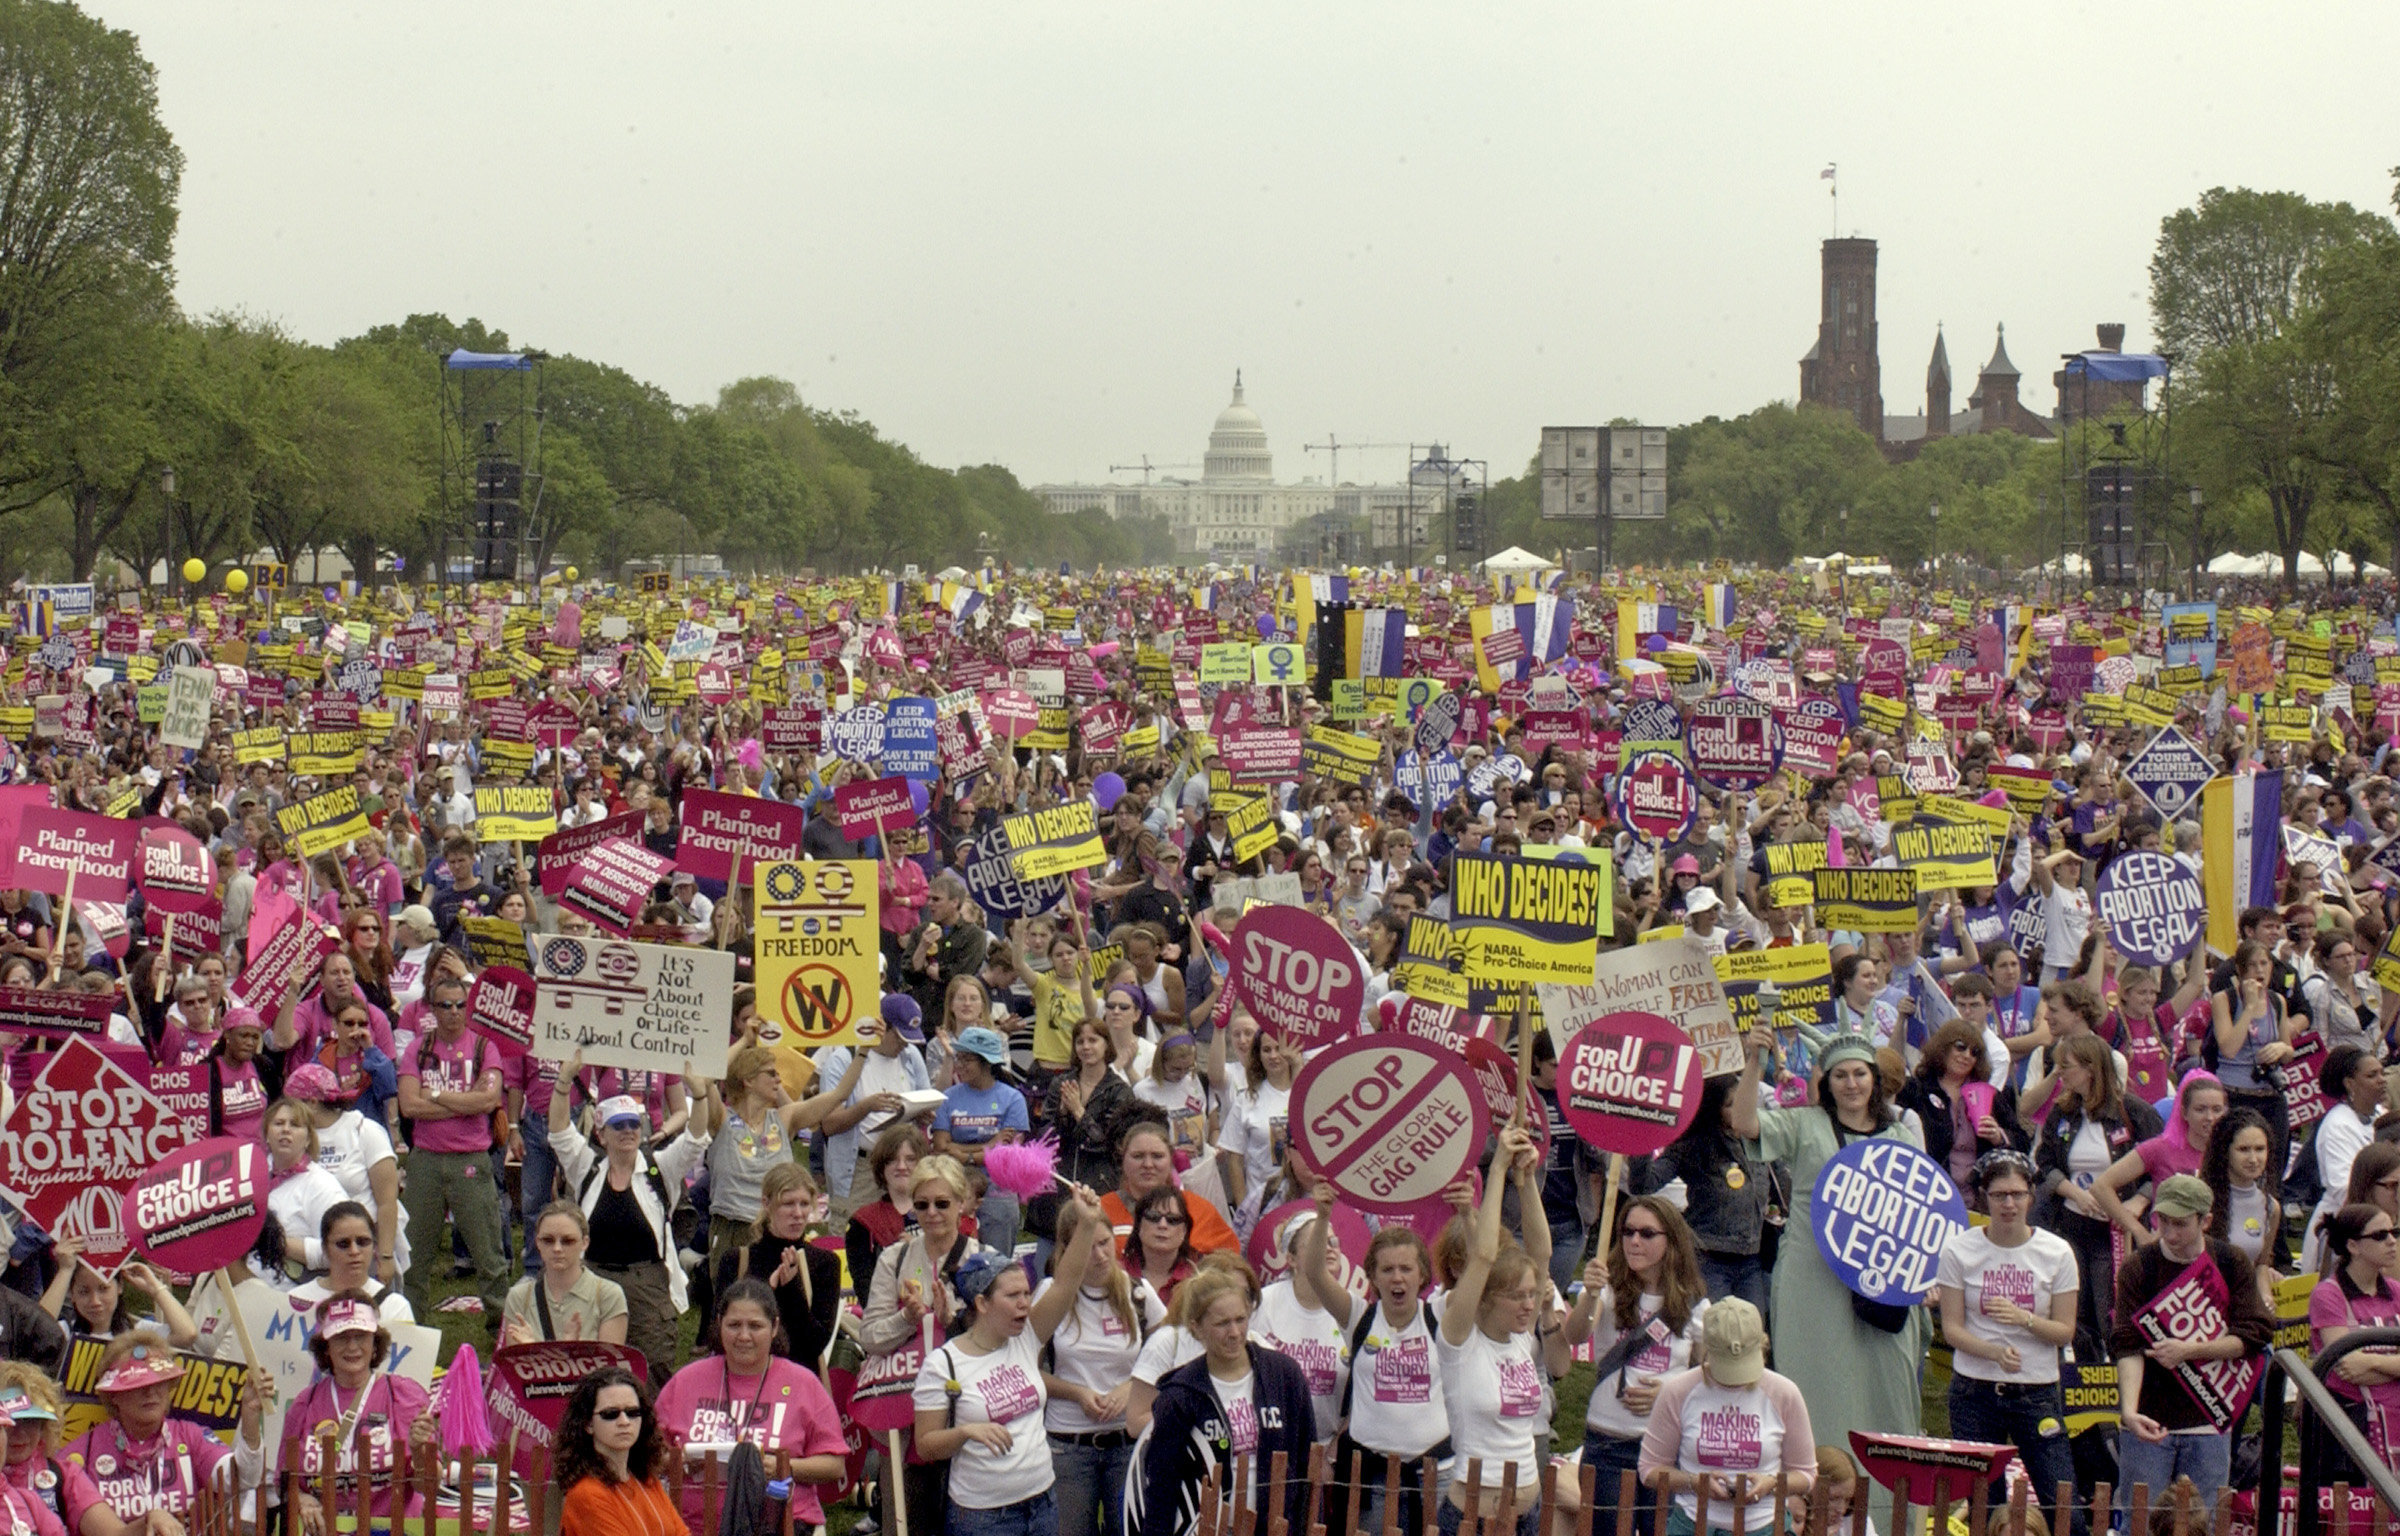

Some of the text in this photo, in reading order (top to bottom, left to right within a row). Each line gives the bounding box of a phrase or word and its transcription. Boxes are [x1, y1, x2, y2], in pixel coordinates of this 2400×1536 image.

[256, 566, 285, 588] B4
[1867, 651, 1902, 665] VOTE
[1366, 678, 1381, 694] WHO
[323, 692, 347, 700] KEEP
[996, 698, 1032, 710] Planned
[313, 701, 358, 710] ABORTION
[323, 710, 350, 719] LEGAL
[846, 706, 885, 722] KEEP
[896, 706, 925, 717] KEEP
[987, 708, 1039, 720] Parenthood
[1698, 701, 1771, 716] STUDENTS
[1799, 702, 1838, 717] KEEP
[776, 710, 806, 720] KEEP
[886, 717, 936, 728] ABORTION
[1623, 702, 1656, 730] KEEP
[1785, 713, 1824, 727] KEEP
[764, 720, 820, 731] ABORTION
[834, 722, 885, 739] ABORTIO
[891, 727, 928, 739] LEGAL
[935, 717, 958, 734] STOP
[1534, 720, 1571, 732] Planned
[1696, 726, 1724, 742] FOR
[233, 726, 282, 751] WHO DECIDES?
[290, 734, 314, 753] WHO
[773, 731, 809, 743] LEGAL
[1230, 739, 1300, 750] REPRODUCTIVOS
[1526, 730, 1580, 741] Parenthood
[837, 739, 885, 756] LEGAL
[940, 737, 968, 756] WAR
[1232, 749, 1299, 759] SON DERECHOS
[884, 751, 935, 761] SAVE THE
[1244, 759, 1290, 769] HUMANOS!
[1321, 751, 1341, 764] YOUR
[2147, 752, 2191, 764] YOUNG
[888, 761, 930, 773] COURT!
[949, 755, 988, 779] CHOICE
[2132, 770, 2208, 781] MOBILIZING
[2137, 762, 2203, 772] FEMINISTS
[1210, 770, 1230, 790] WHO
[1634, 783, 1653, 795] FOR
[1878, 775, 1901, 798] WHO
[475, 786, 554, 813] WHO DECIDES?
[849, 792, 898, 811] Planned
[1934, 801, 1964, 813] NARAL
[277, 784, 362, 835] WHO DECIDES?
[842, 800, 914, 824] Parenthood
[702, 810, 781, 841] Planned
[1004, 802, 1096, 848] WHO DECIDES?
[38, 829, 115, 859] Planned
[557, 821, 628, 850] Planned
[1896, 824, 1989, 860] WHO DECIDES?
[145, 847, 171, 861] FOR
[681, 829, 797, 862] Parenthood
[17, 846, 129, 880] Parenthood
[590, 845, 662, 884] REPRODUCTIVOS
[1032, 855, 1057, 865] NARAL
[1767, 842, 1827, 874] WHO DECIDES?
[579, 857, 648, 896] SON DERECHOS
[1921, 870, 1993, 884] Pro-Choice America
[1922, 871, 1947, 882] NARAL
[2110, 852, 2176, 888] KEEP
[581, 874, 630, 906] HUMANOS!
[983, 875, 1066, 911] LEGAL
[1457, 858, 1599, 927] WHO DECIDES?
[1817, 877, 1916, 901] WHO DECIDES?
[2101, 878, 2202, 926] ABORTION
[1409, 920, 1448, 960] WHO
[2115, 913, 2200, 951] LEGAL
[762, 937, 862, 957] FREEDOM
[1484, 943, 1525, 957] NARAL
[662, 955, 694, 972] It's
[1242, 930, 1352, 1002] STOP
[1483, 956, 1593, 975] Pro-Choice America
[1730, 953, 1770, 968] NARAL
[1730, 956, 1827, 978] Pro-Choice America
[658, 971, 692, 988] Not
[1423, 975, 1455, 989] NARAL
[1601, 962, 1704, 1004] WOMAN CAN
[479, 983, 502, 998] FOR
[653, 989, 702, 1007] About
[1242, 974, 1341, 1022] THE WAR ON
[1669, 982, 1719, 1012] FREE
[1780, 986, 1830, 1005] CHOICE
[11, 996, 85, 1012] LEGAL
[643, 1001, 701, 1021] Choice
[1255, 998, 1320, 1037] WOMEN
[1773, 1008, 1822, 1026] THEIRS.
[545, 1023, 695, 1055] It's About Control
[1575, 1045, 1619, 1072] FOR
[27, 1088, 143, 1130] STOP
[1312, 1054, 1404, 1148] STOP
[1570, 1095, 1678, 1125] plannedparenthood.org
[952, 1115, 998, 1127] AGAINST
[1390, 1096, 1449, 1155] GLOBAL
[1368, 1104, 1468, 1197] GAG RULE
[10, 1160, 94, 1190] Against
[1860, 1143, 1952, 1202] KEEP
[137, 1180, 180, 1205] FOR
[1821, 1164, 1966, 1250] ABORTION
[147, 1204, 255, 1249] plannedparenthood.org
[1824, 1210, 1938, 1294] LEGAL
[1983, 1270, 2035, 1286] MAKING
[1981, 1285, 2034, 1299] HISTORY!
[282, 1361, 296, 1375] IS
[2065, 1388, 2119, 1407] CHOICE
[694, 1409, 725, 1424] FOR
[1721, 1405, 1740, 1414] I'M
[1701, 1412, 1761, 1428] MAKING
[1699, 1427, 1761, 1441] HISTORY!
[1699, 1440, 1726, 1449] March
[1867, 1443, 1989, 1472] plannedparenthood.org
[100, 1478, 135, 1497] FOR
